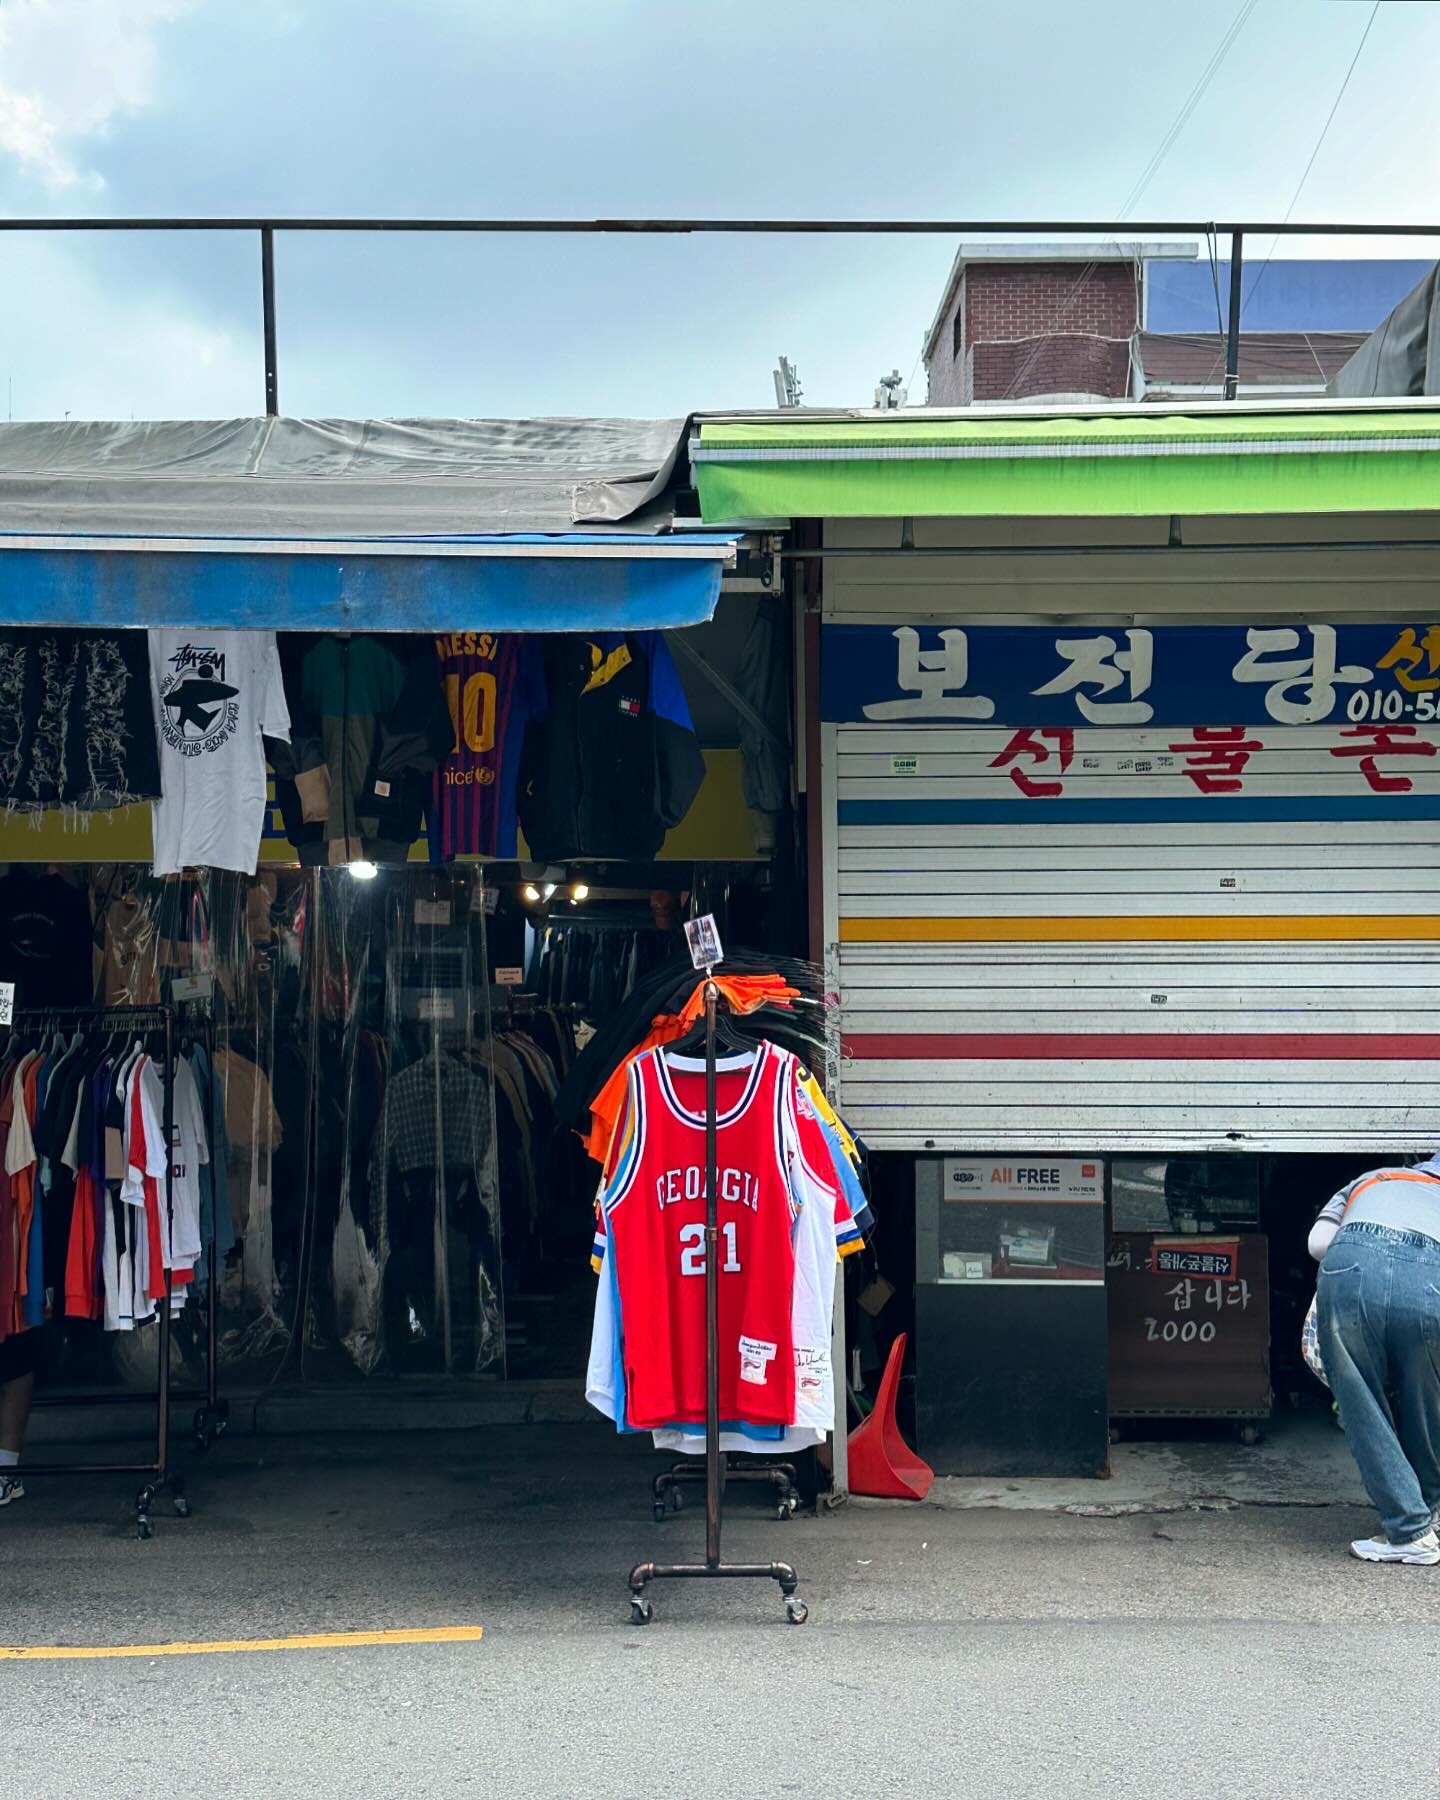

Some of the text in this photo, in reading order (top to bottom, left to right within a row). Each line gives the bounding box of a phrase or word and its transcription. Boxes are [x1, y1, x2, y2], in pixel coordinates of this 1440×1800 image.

[1347, 689, 1440, 722] 010-5
[1017, 1168, 1060, 1184] FREE
[680, 1222, 741, 1275] 21
[1144, 1317, 1216, 1343] 2000
